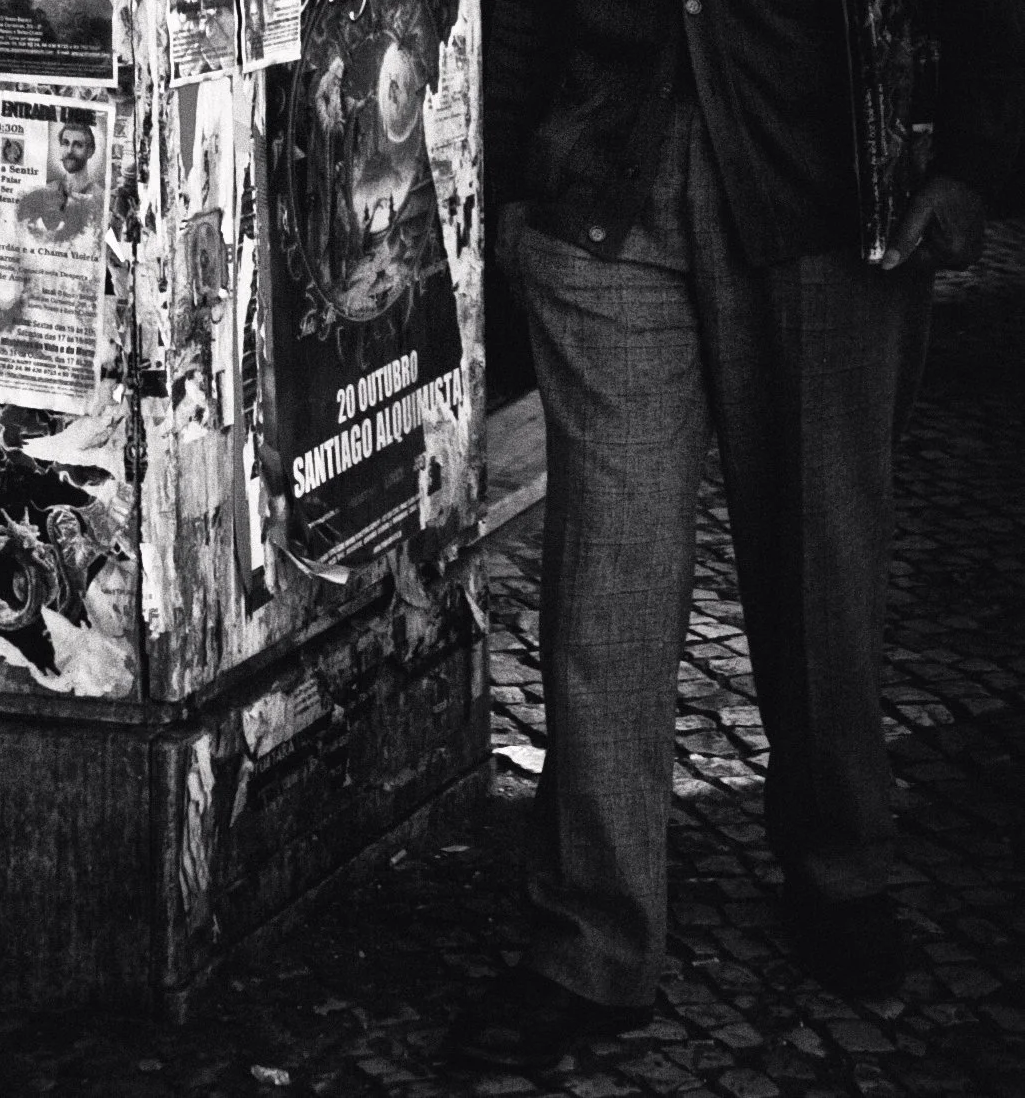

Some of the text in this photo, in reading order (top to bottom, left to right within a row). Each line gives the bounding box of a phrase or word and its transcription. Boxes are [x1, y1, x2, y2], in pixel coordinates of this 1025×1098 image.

[1, 100, 57, 122] ENTRADA
[9, 165, 40, 176] Sentir
[1, 175, 22, 184] Falar
[1, 186, 14, 194] Ser
[38, 247, 68, 258] Chama
[336, 349, 419, 424] 20 OUTUBRO
[292, 366, 464, 499] SANTIAGO ALQUIMISTA
